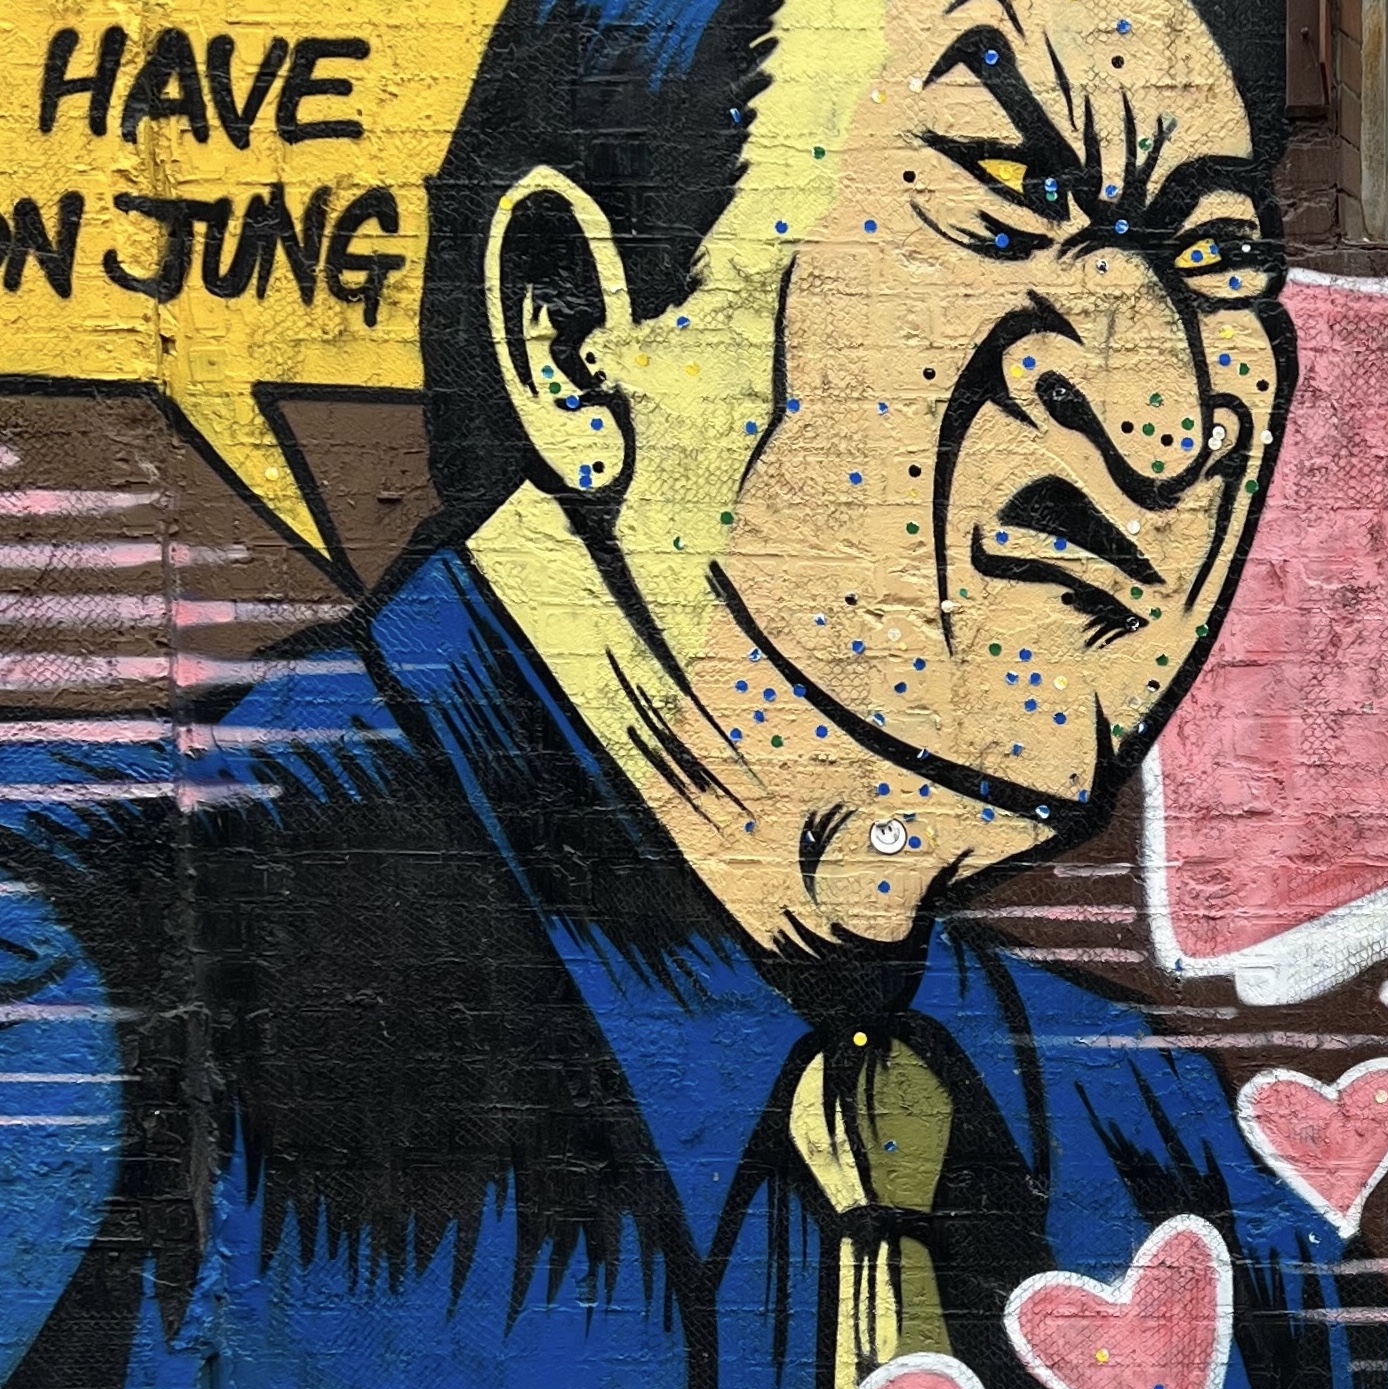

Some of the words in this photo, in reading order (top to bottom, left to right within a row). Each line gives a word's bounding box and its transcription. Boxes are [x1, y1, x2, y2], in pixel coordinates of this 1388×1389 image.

[39, 25, 371, 149] HAVE
[0, 190, 86, 299] N
[102, 184, 406, 327] JUNG
